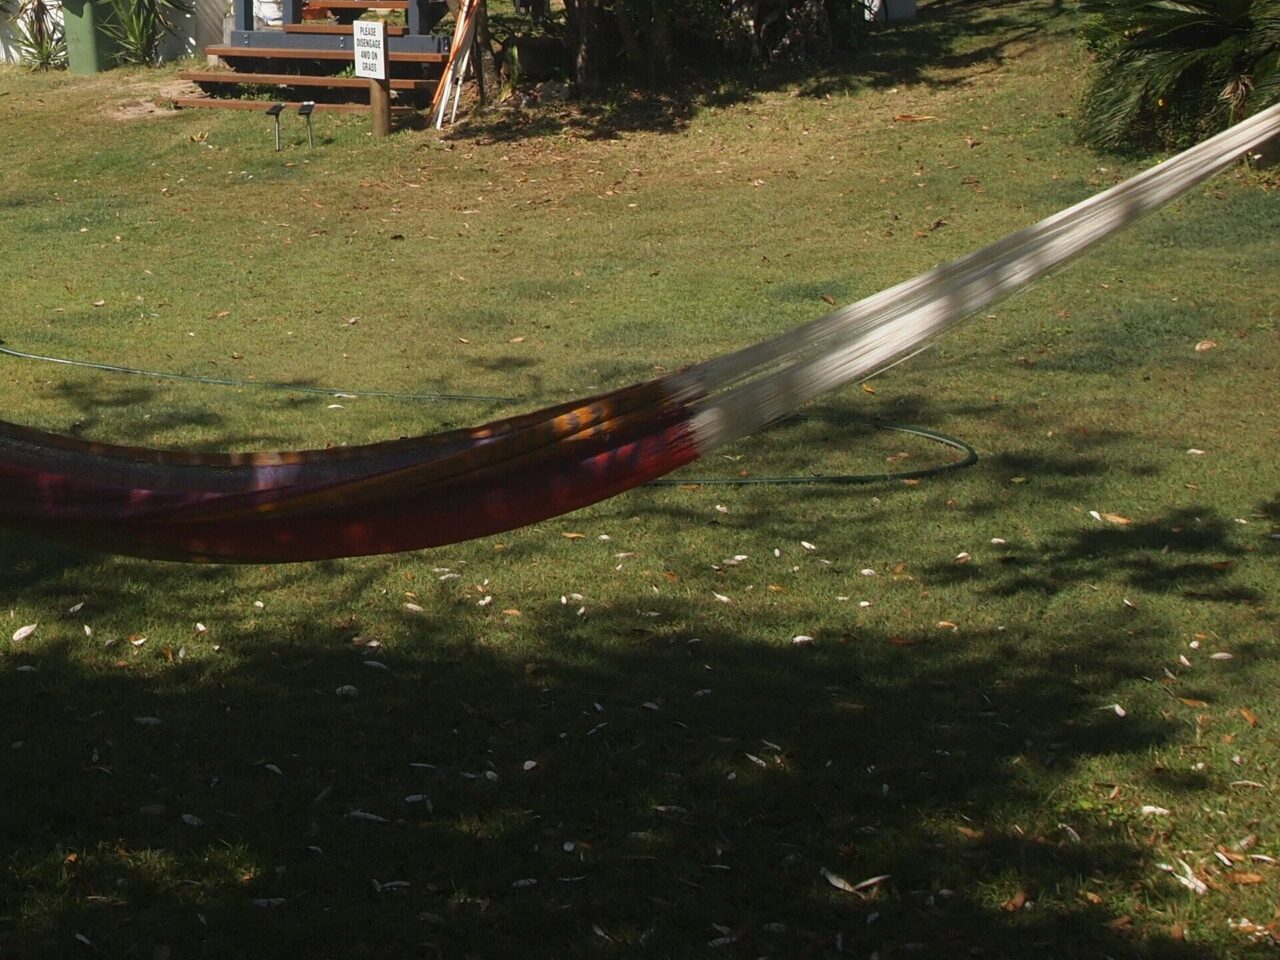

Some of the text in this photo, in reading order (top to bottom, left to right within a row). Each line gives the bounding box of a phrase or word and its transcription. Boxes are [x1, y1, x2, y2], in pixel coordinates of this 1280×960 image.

[360, 26, 376, 36] PLEASE
[356, 37, 381, 49] DISENGAGE
[371, 51, 378, 60] ON
[362, 62, 377, 72] GRASS
